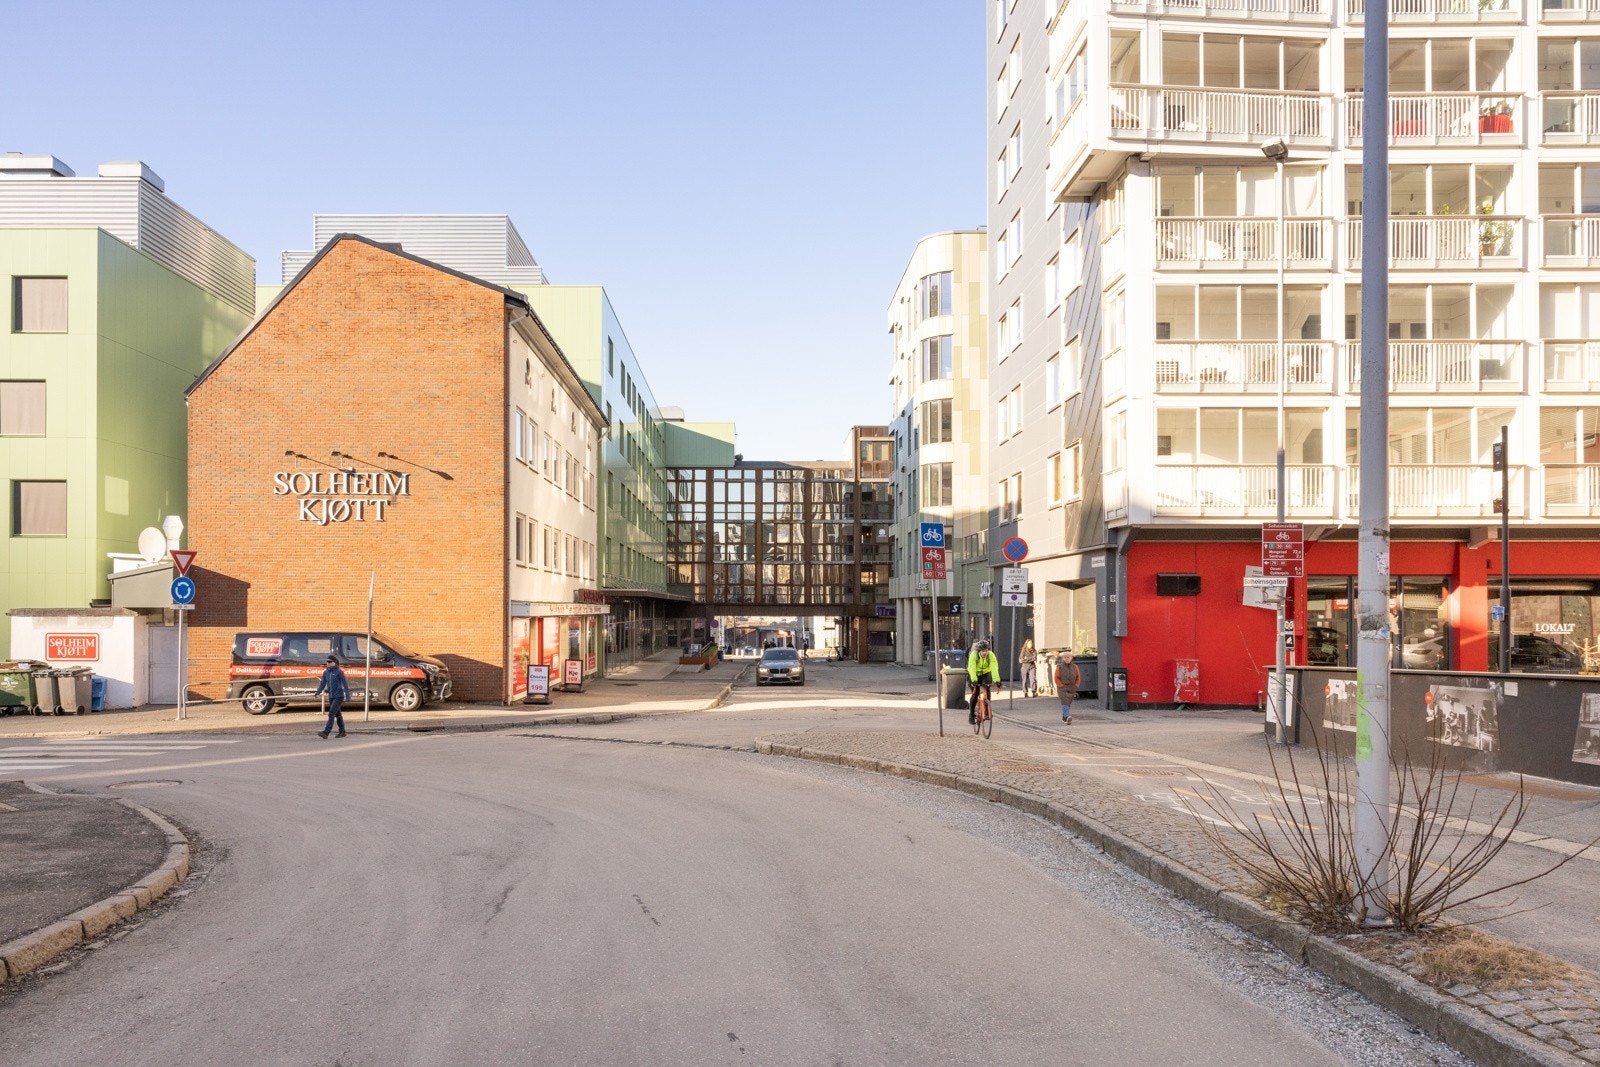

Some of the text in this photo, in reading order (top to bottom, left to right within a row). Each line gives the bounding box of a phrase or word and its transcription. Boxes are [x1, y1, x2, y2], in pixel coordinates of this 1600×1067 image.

[273, 472, 409, 495] SOLHEIM
[298, 498, 389, 525] KJØTT
[952, 604, 960, 613] S
[1535, 623, 1576, 632] LOKALT
[49, 637, 96, 648] SOLHEIM
[57, 646, 89, 657] KJØTT
[371, 669, 413, 677] Kantinedrift
